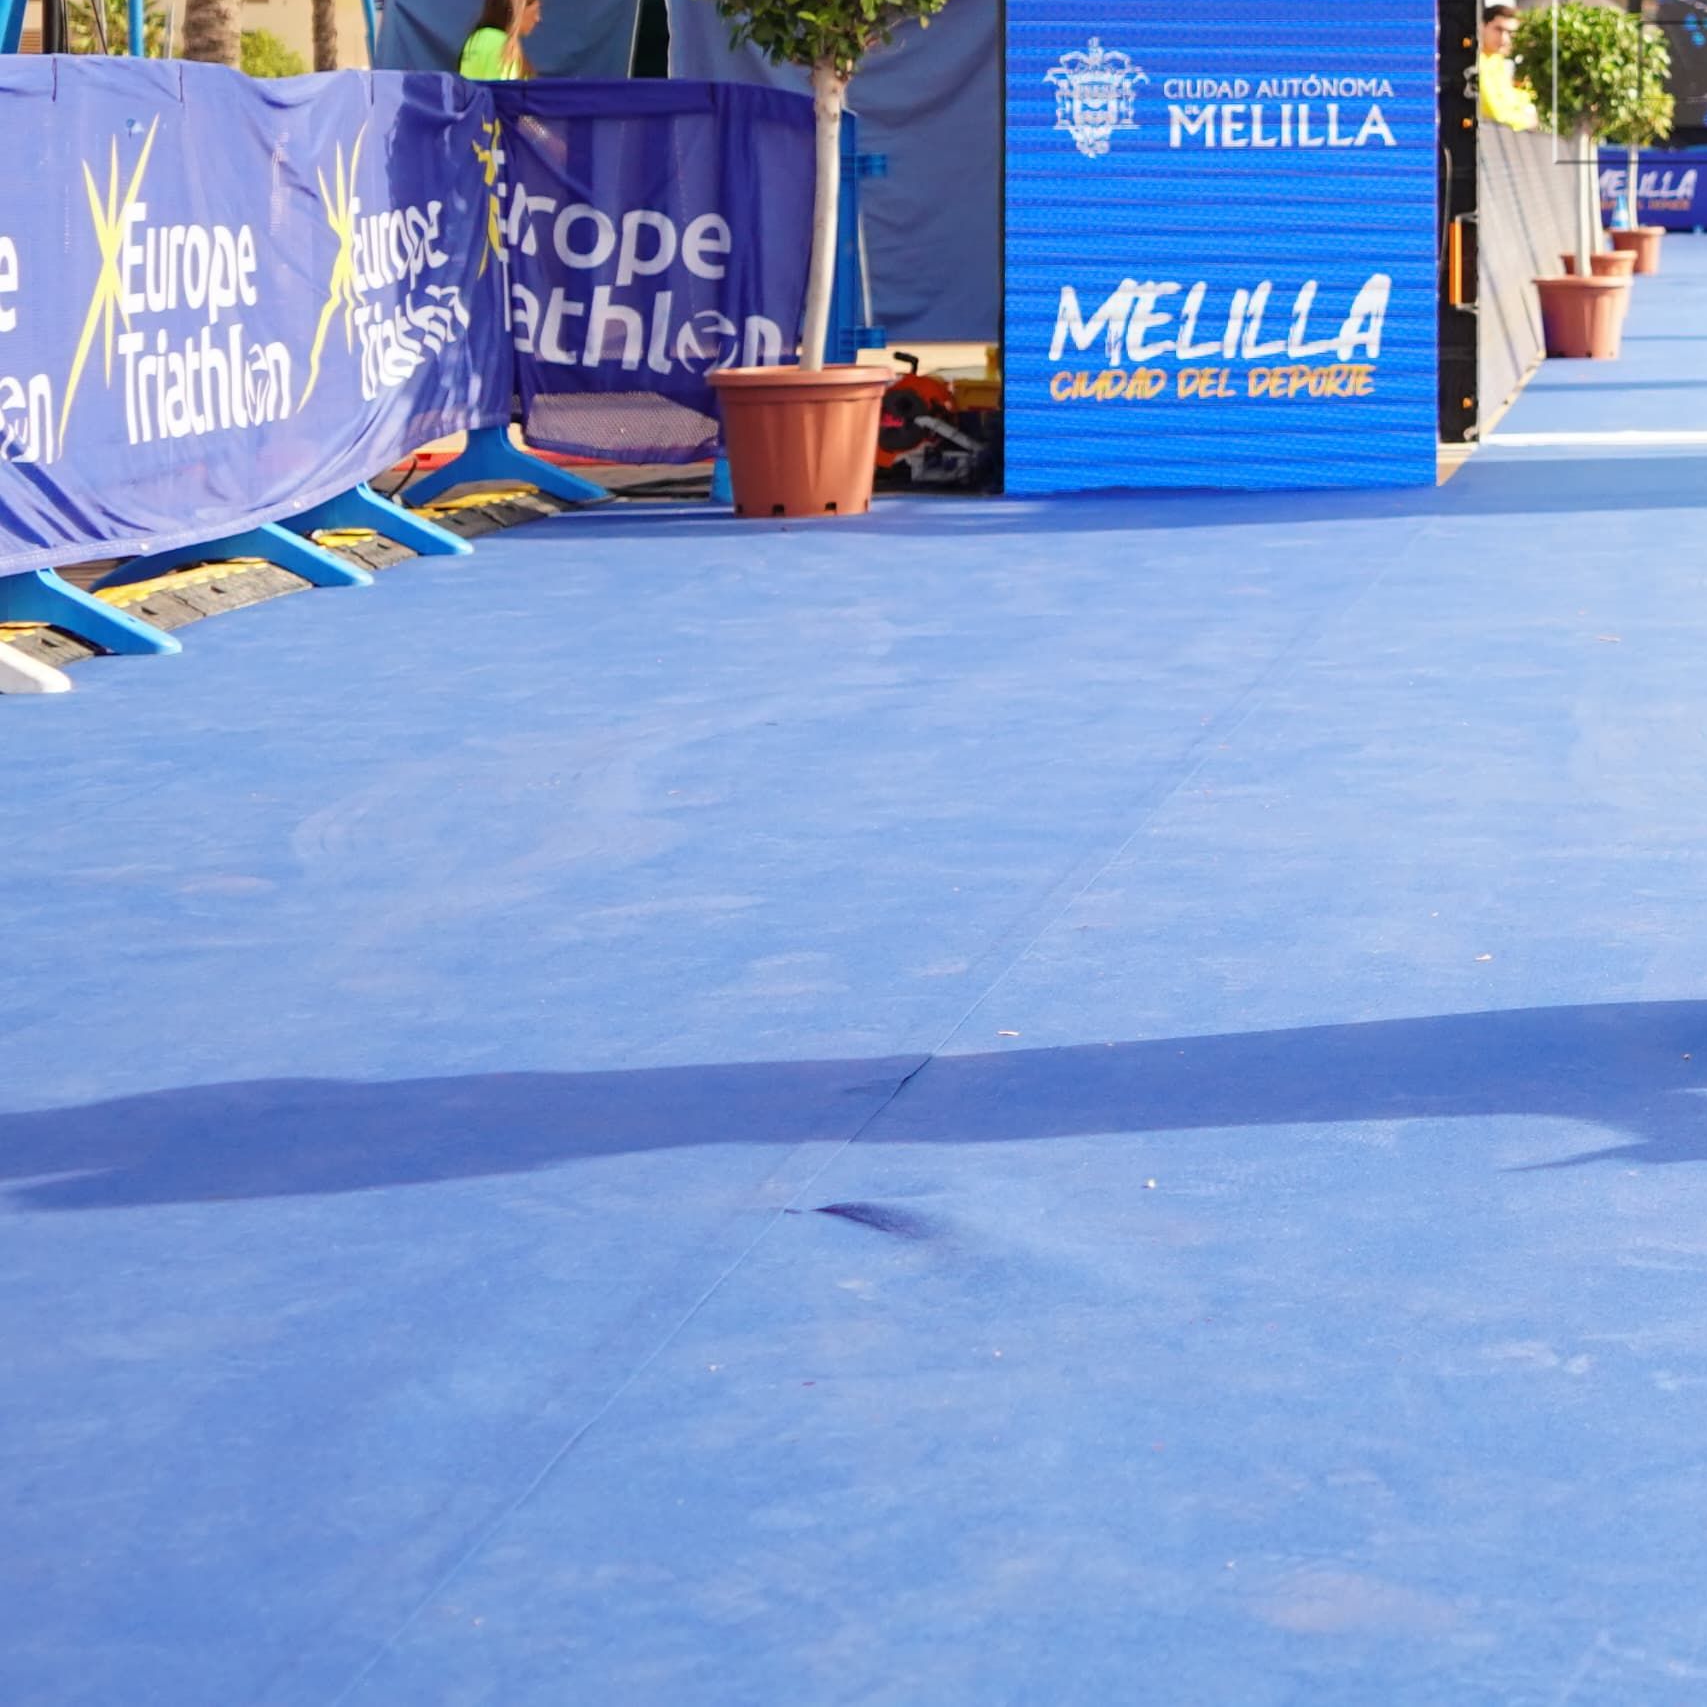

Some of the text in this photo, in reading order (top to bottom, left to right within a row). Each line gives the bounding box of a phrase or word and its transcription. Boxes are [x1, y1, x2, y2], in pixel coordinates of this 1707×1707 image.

[1164, 73, 1395, 99] CIUDAD AUTÓNOMA
[1168, 102, 1397, 149] MELILLA
[120, 200, 258, 316] Europe
[352, 199, 449, 291] Europe
[1048, 272, 1392, 367] MELILLA
[117, 318, 293, 447] Triathlon
[1050, 363, 1378, 403] CIUDAD DEL DEPORTE
